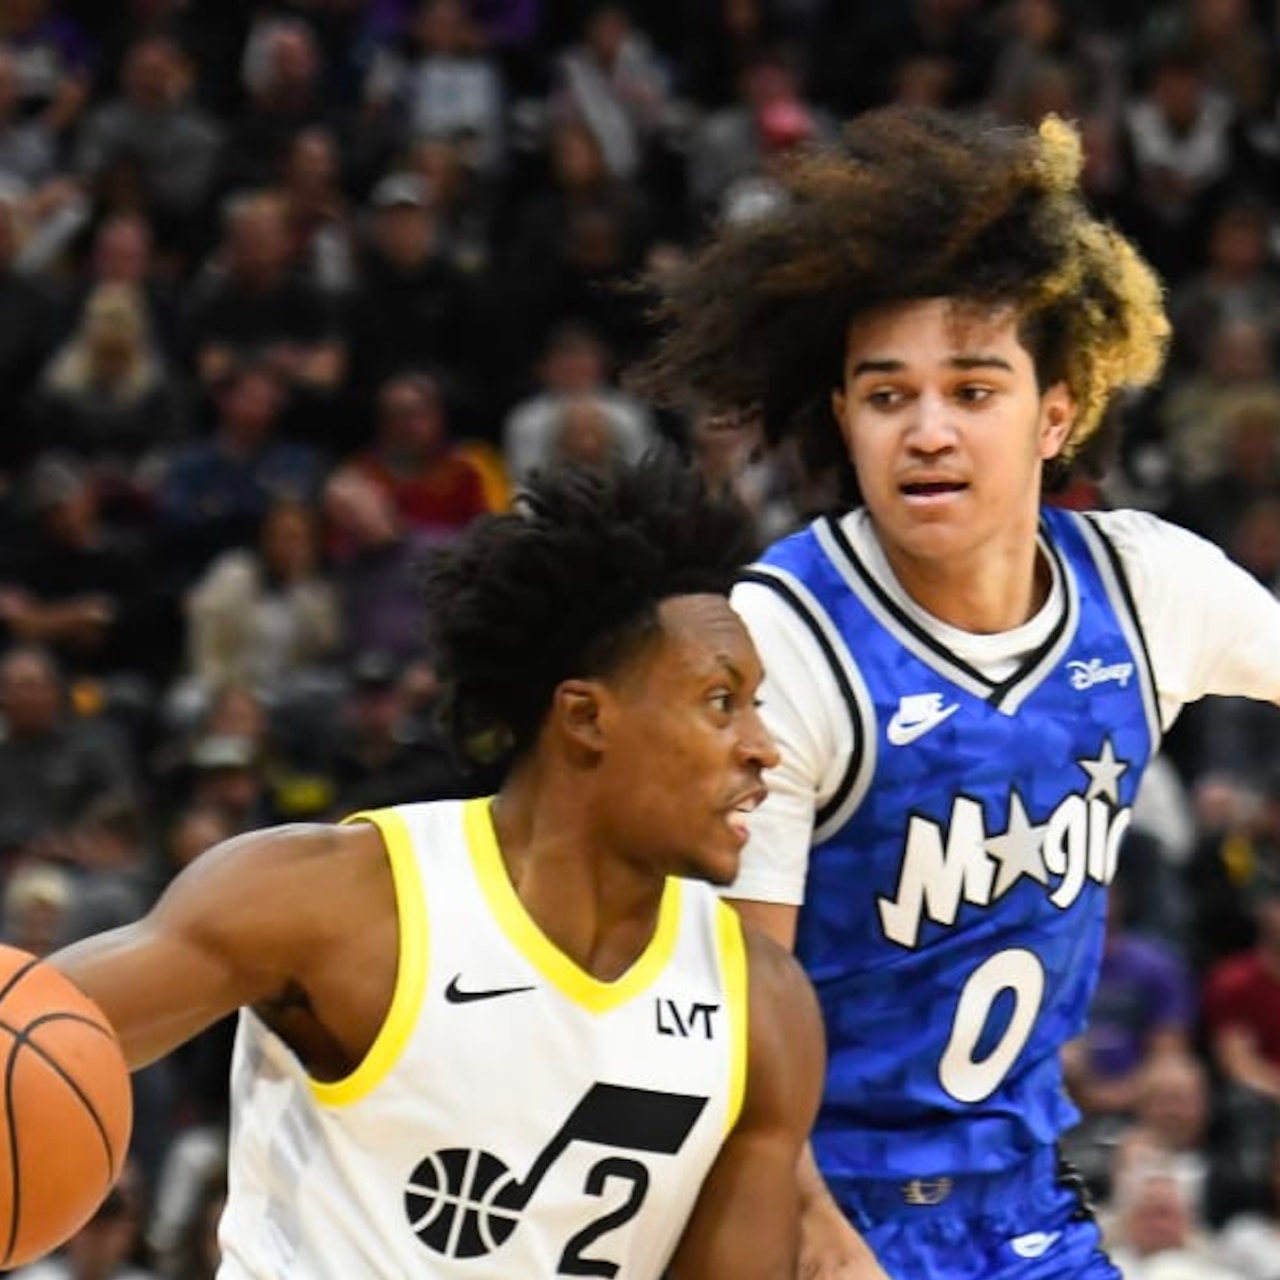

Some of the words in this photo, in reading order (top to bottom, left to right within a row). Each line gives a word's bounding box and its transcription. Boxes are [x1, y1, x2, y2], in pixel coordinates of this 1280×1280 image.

[1065, 658, 1134, 691] Disney
[656, 996, 721, 1041] LVT
[937, 948, 1046, 1103] 0
[556, 1156, 651, 1280] 2
